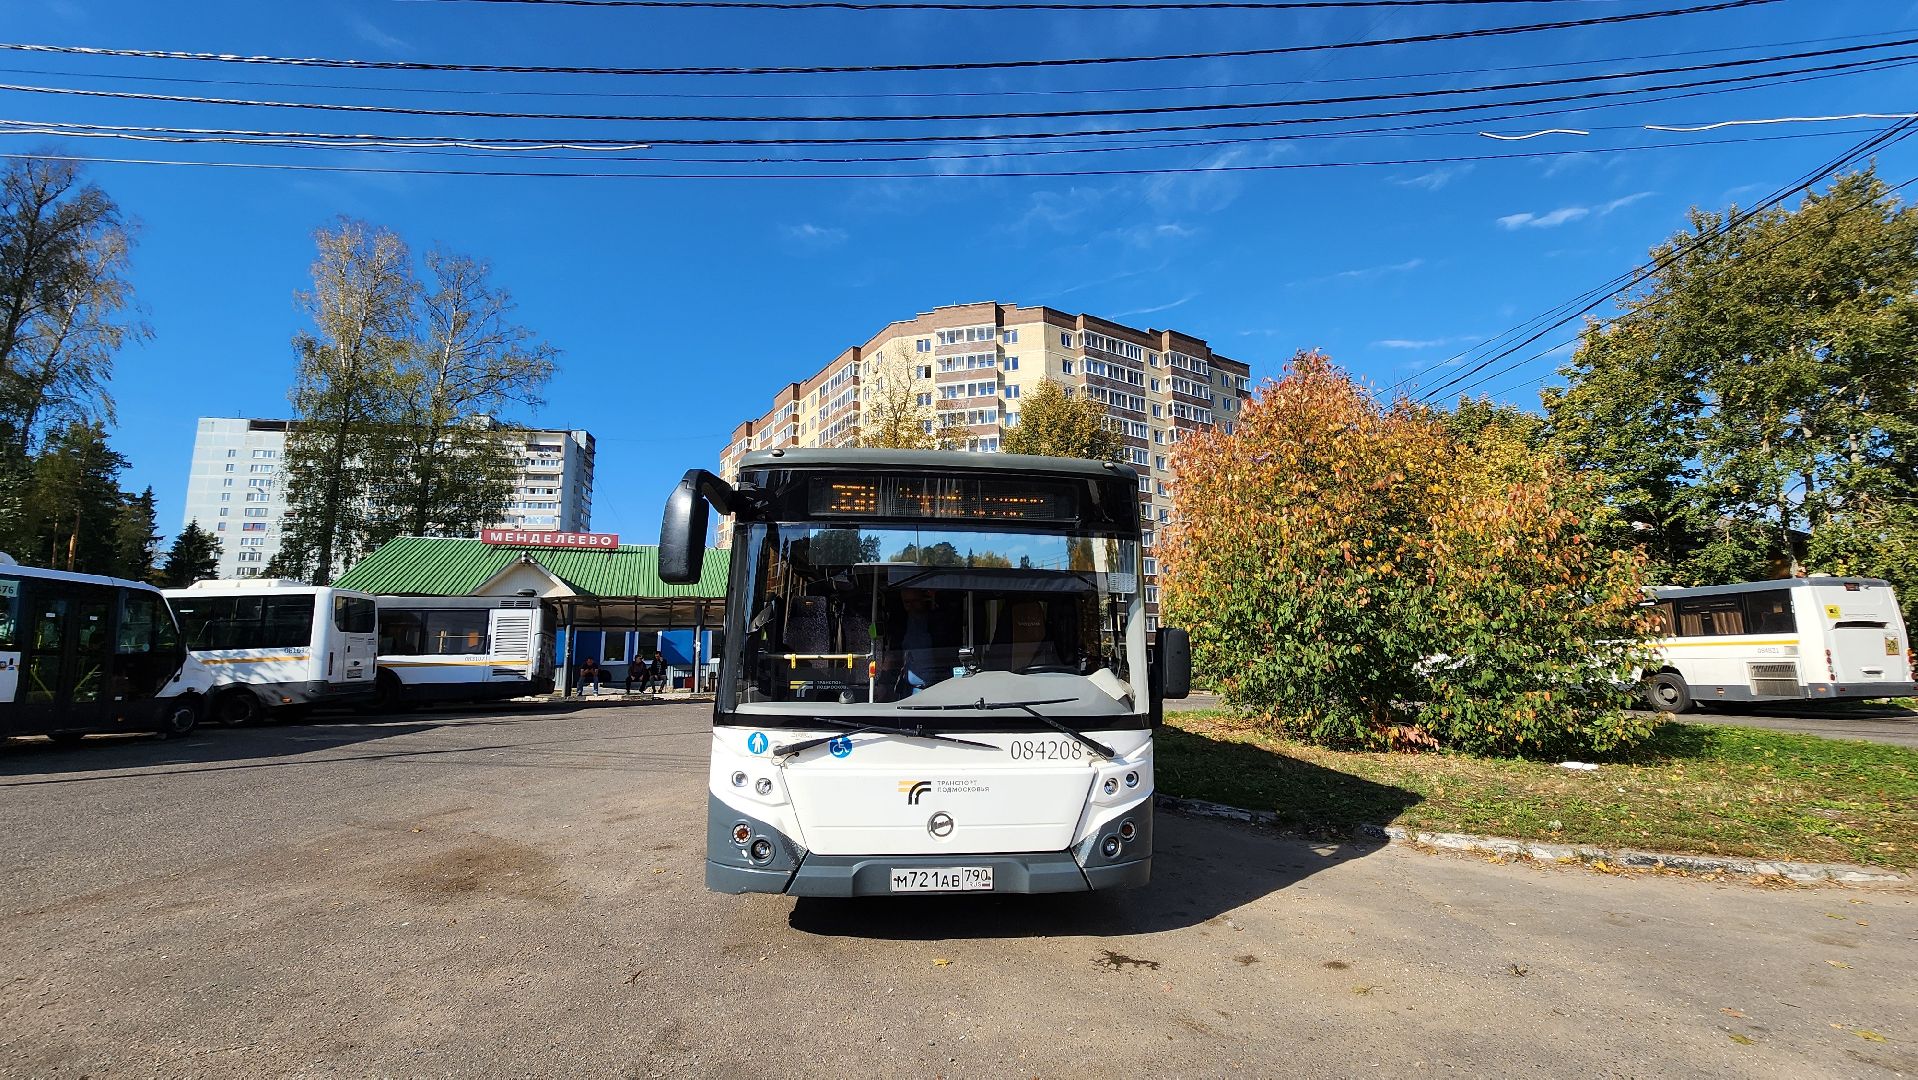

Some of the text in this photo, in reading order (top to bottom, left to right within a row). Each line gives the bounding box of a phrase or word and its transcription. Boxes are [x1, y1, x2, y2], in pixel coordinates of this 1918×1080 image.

[490, 532, 612, 546] МЕНДЕЛЕЕВО
[0, 585, 14, 594] 76
[1010, 740, 1082, 760] 084208
[964, 869, 988, 882] 790
